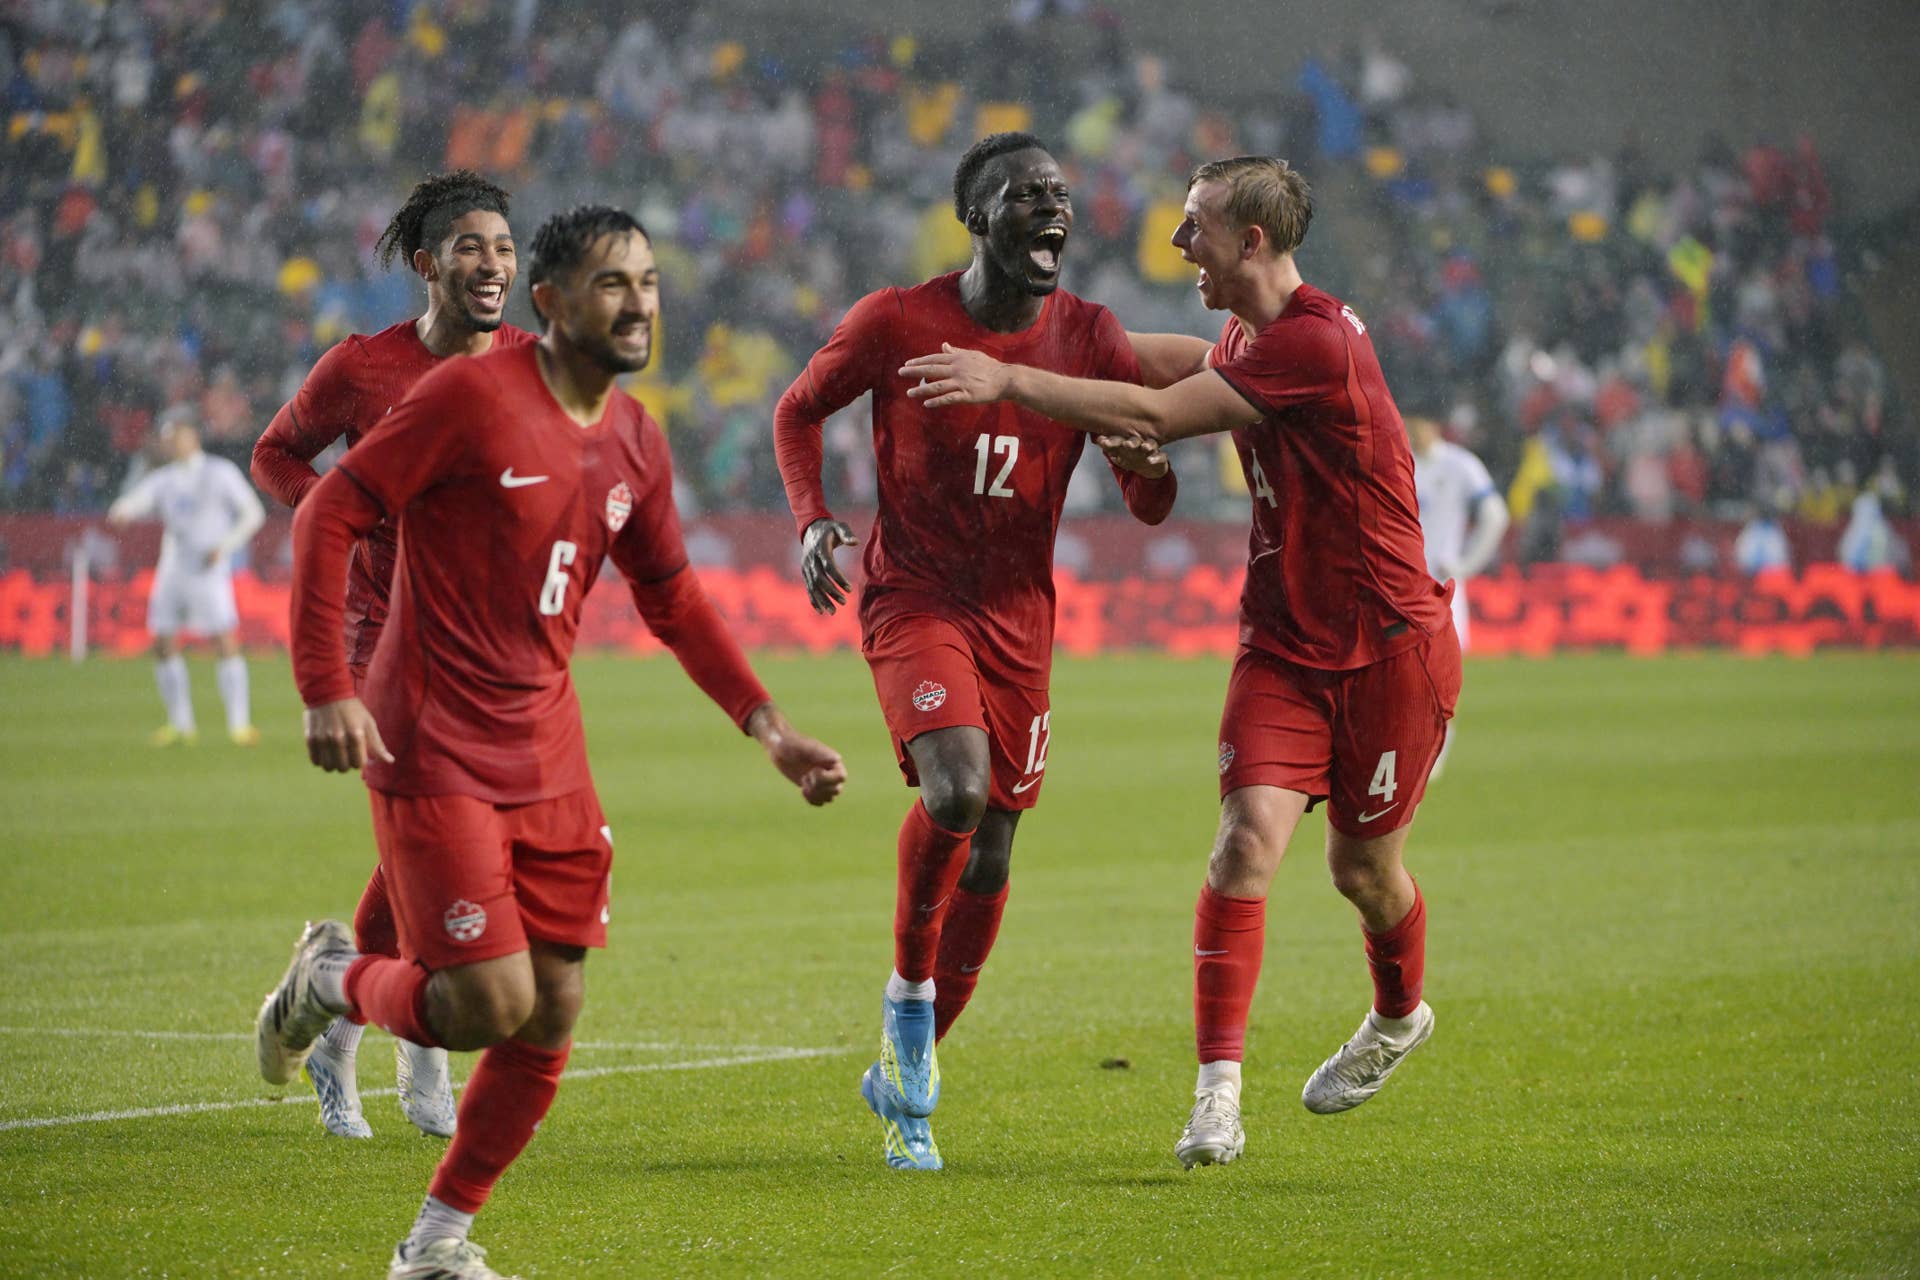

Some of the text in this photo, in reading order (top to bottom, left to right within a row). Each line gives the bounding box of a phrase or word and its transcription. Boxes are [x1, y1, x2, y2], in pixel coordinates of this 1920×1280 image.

[973, 432, 1020, 498] 12
[1251, 448, 1278, 509] 4
[538, 540, 577, 616] 6
[914, 689, 945, 703] CANADA
[1368, 750, 1398, 802] 4
